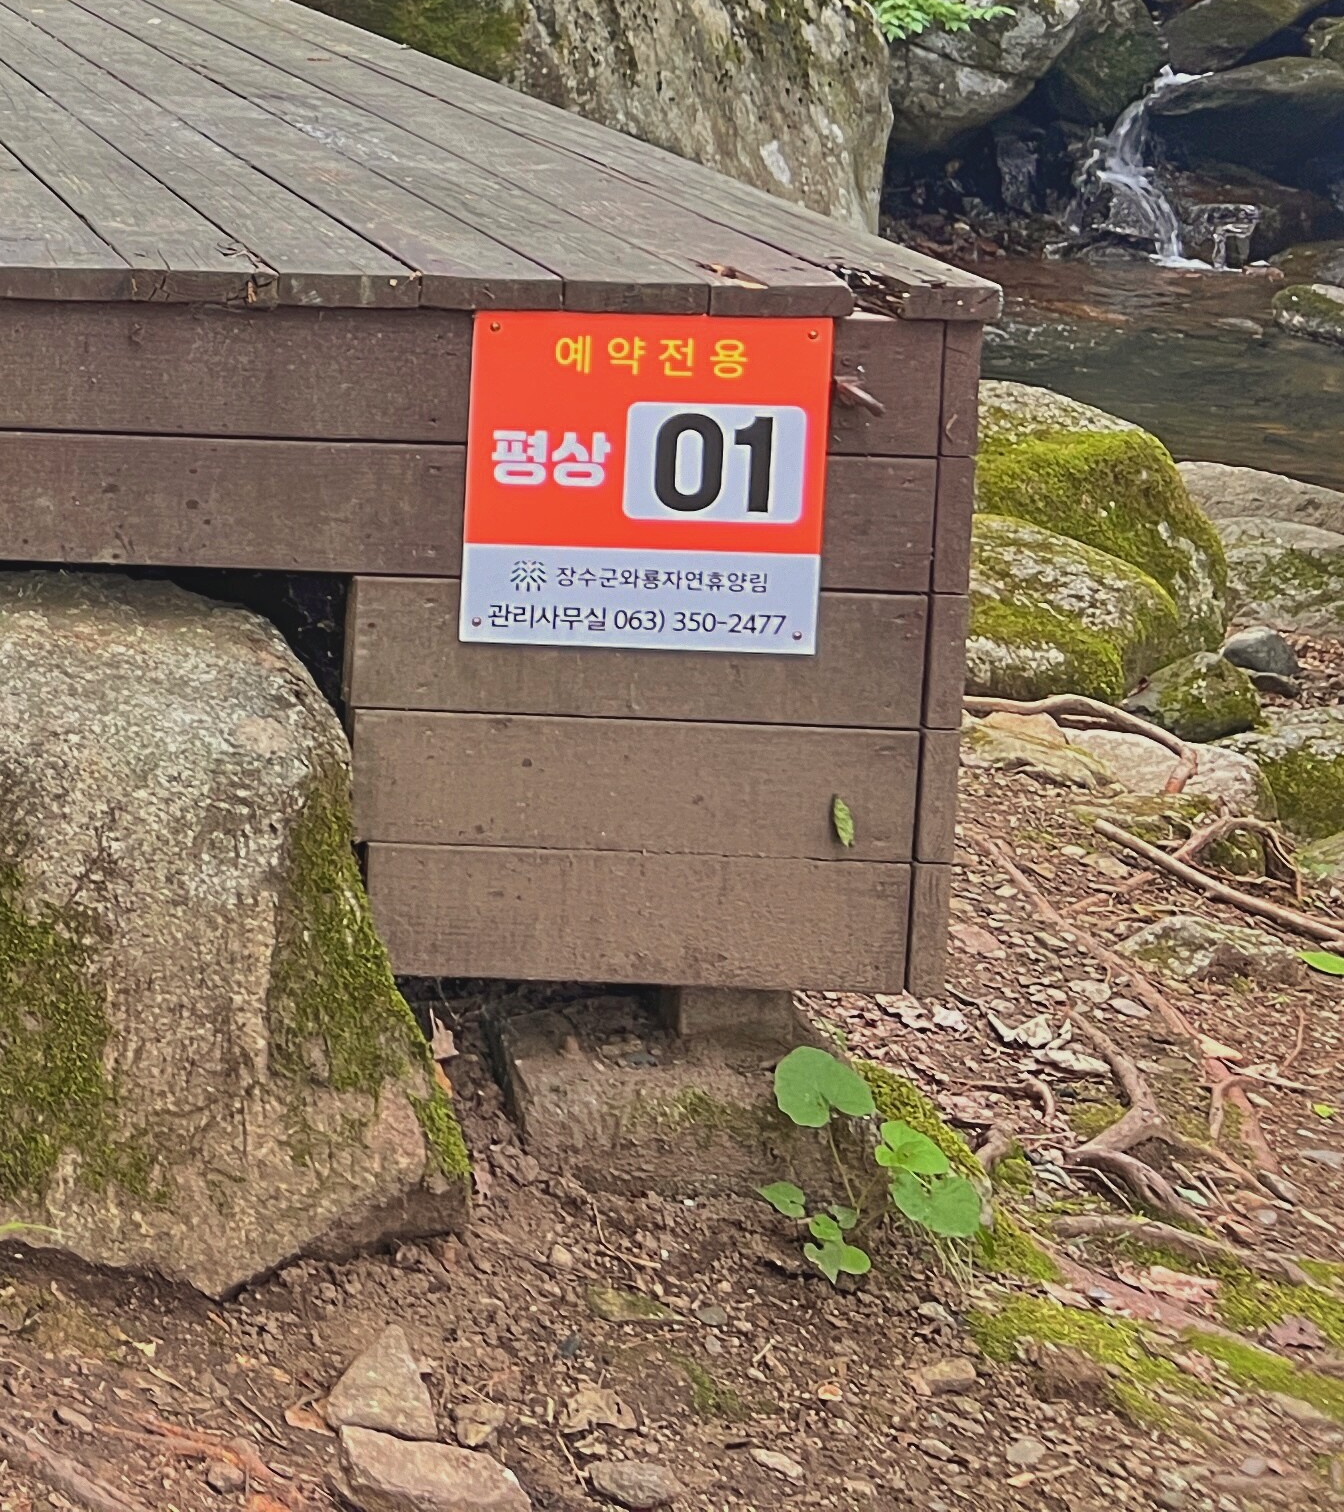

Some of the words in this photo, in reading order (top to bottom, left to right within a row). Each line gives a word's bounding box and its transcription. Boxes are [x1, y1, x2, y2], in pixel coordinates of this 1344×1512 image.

[491, 430, 611, 487] 평상
[654, 413, 775, 514] 01
[556, 567, 768, 593] 장수군와룡자연휴양림
[488, 604, 607, 632] 관리사무실
[614, 609, 665, 633] 063)
[672, 611, 787, 635] 350-2477
